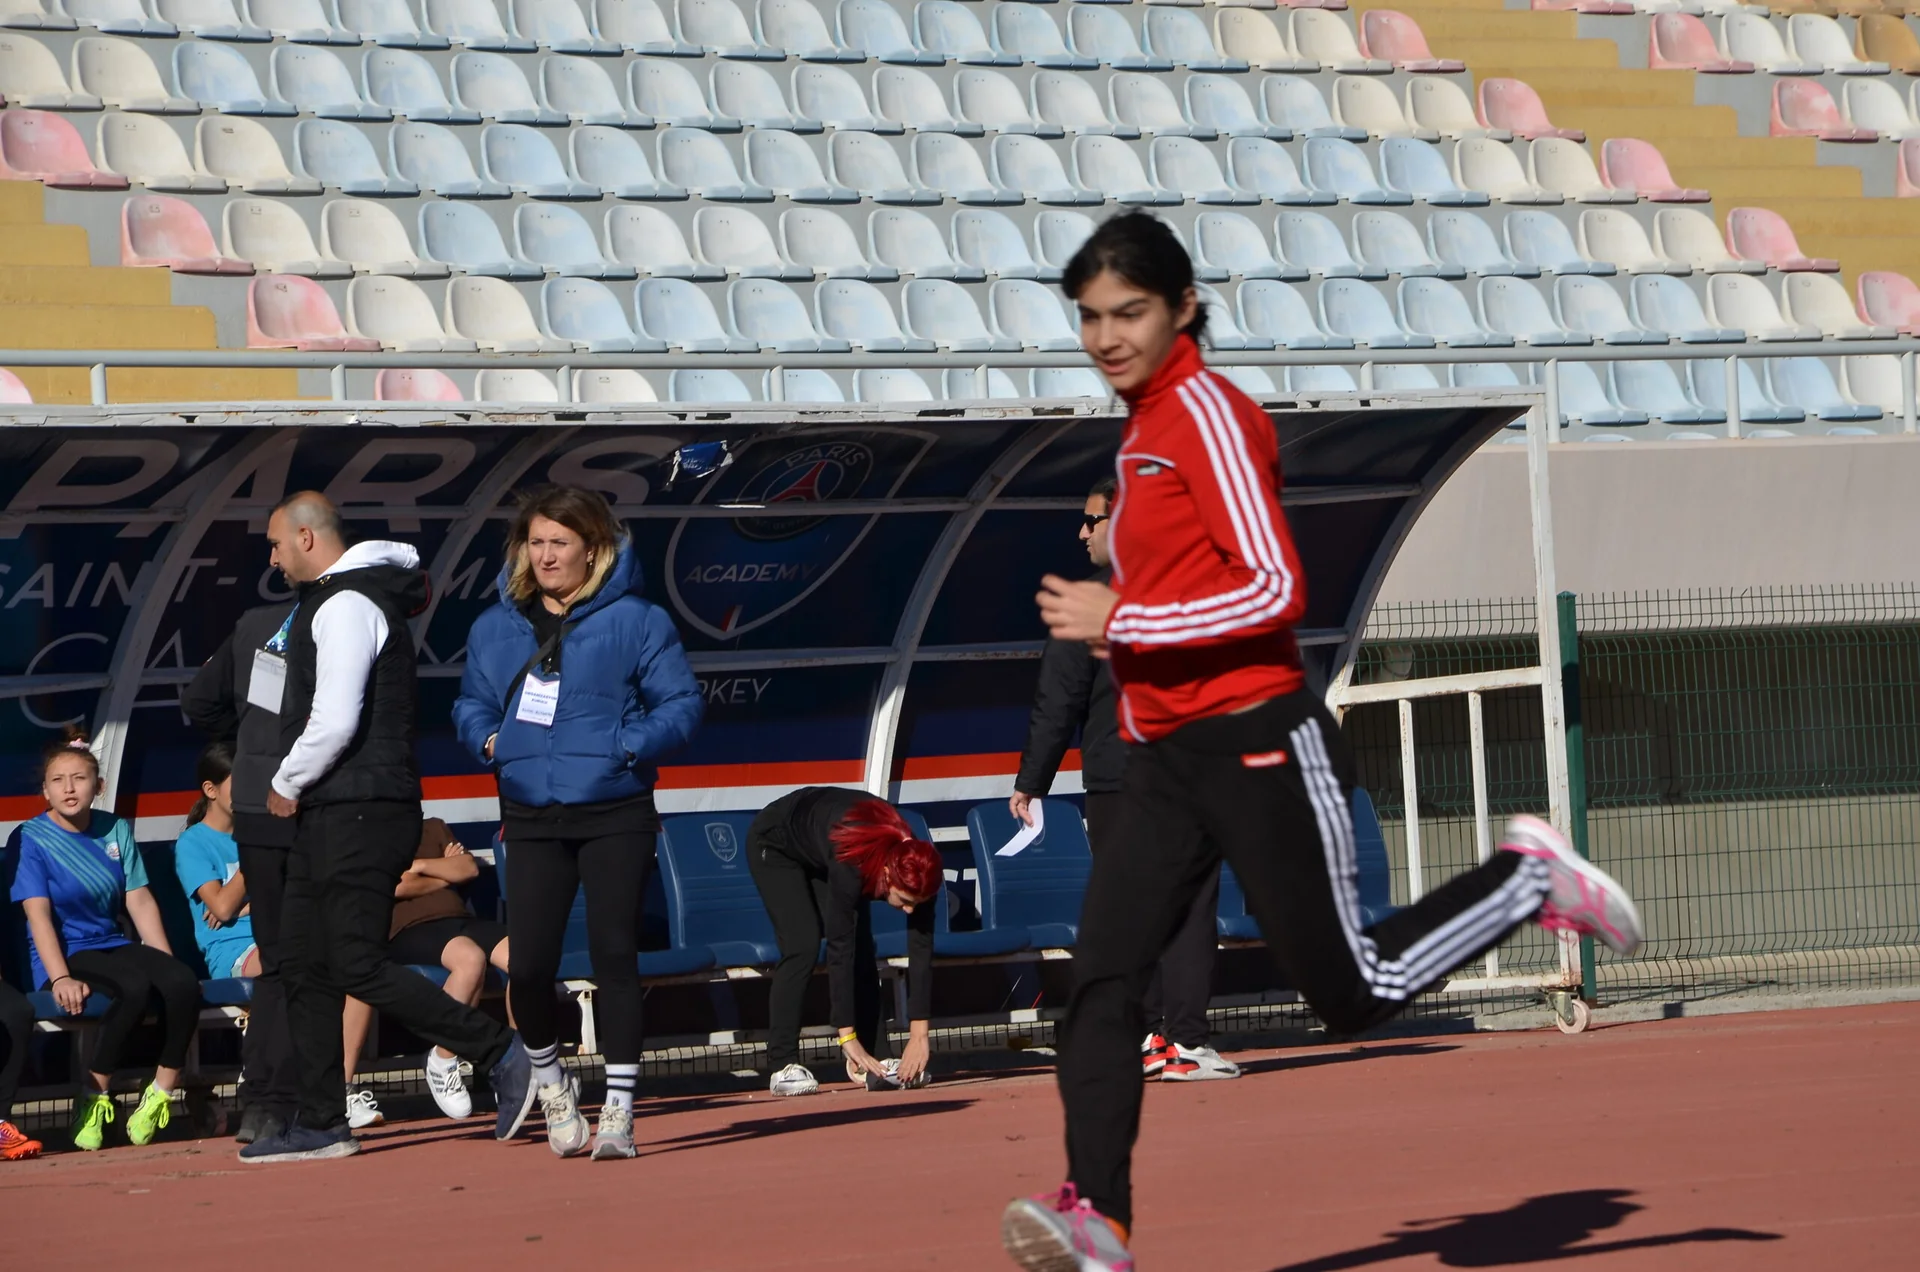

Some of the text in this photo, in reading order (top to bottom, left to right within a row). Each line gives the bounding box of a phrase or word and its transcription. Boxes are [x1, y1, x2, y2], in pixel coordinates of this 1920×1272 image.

[785, 445, 865, 468] PARIS
[0, 436, 683, 539] PARS
[684, 563, 816, 584] ACADEMY
